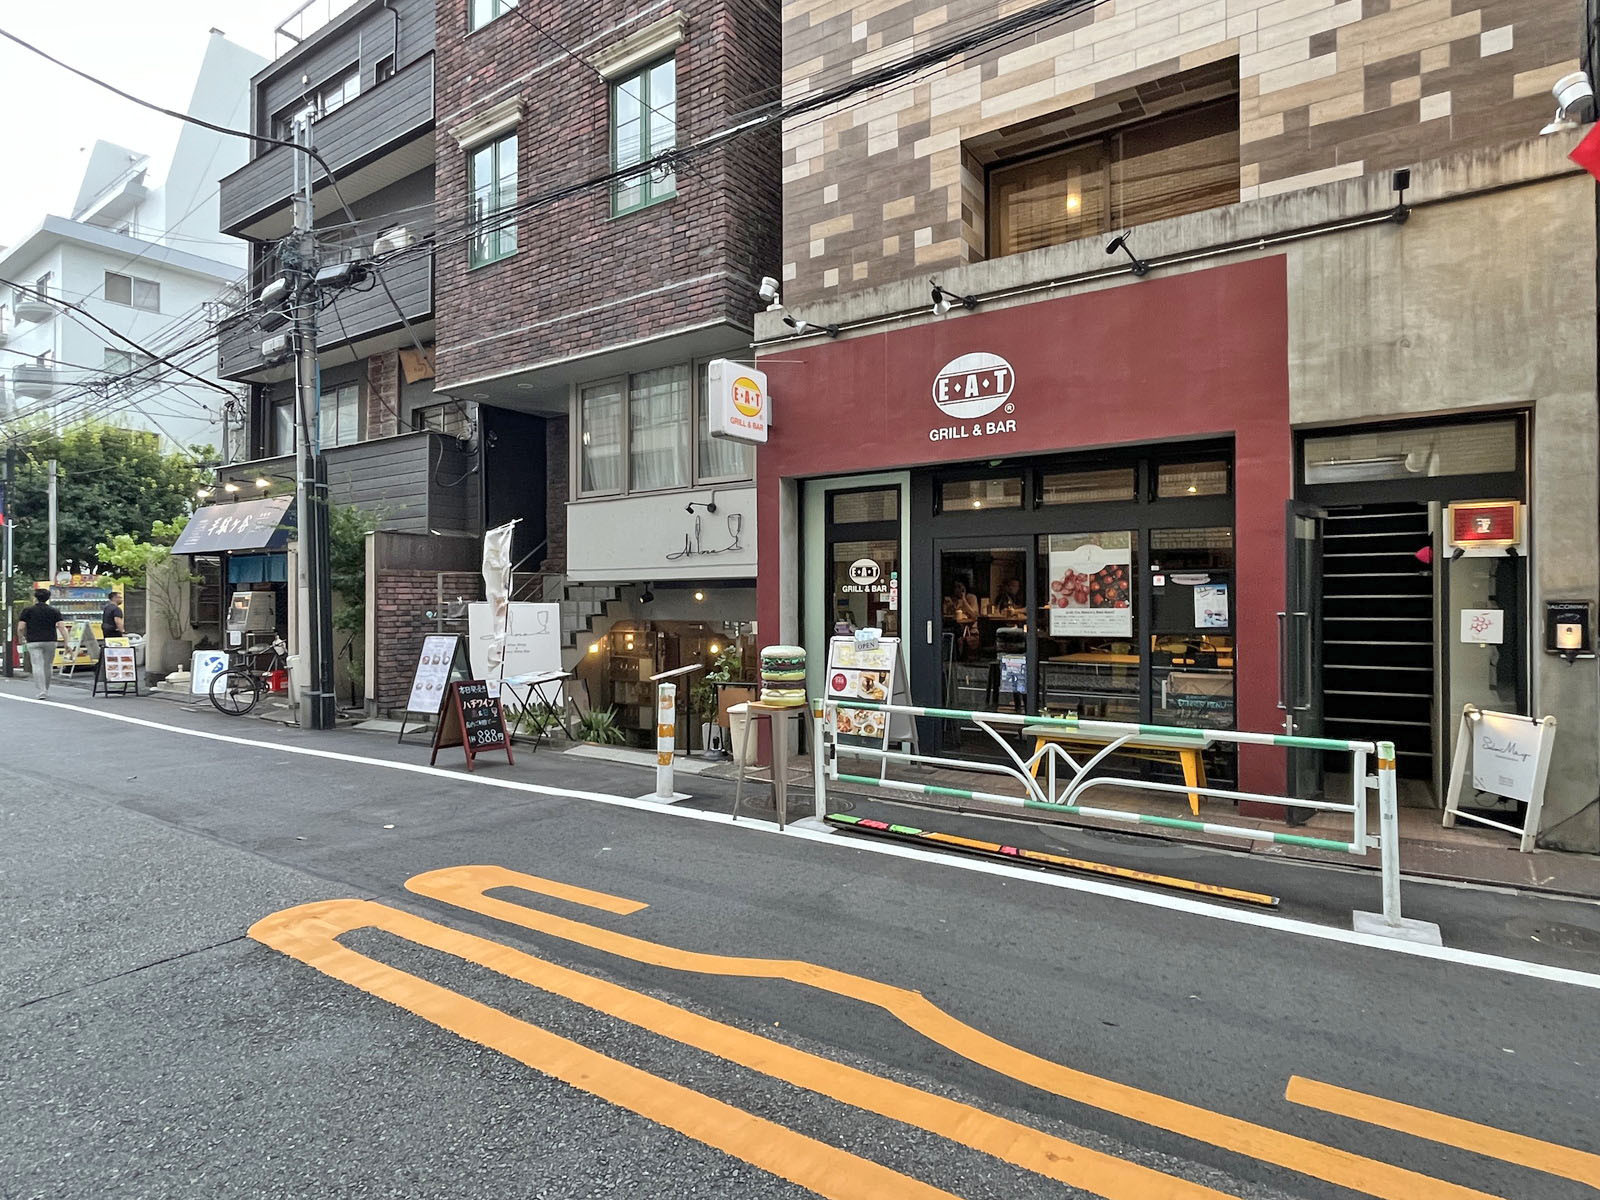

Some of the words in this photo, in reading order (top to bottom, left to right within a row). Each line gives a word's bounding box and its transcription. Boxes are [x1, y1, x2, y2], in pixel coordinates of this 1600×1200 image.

[730, 416, 746, 428] GRILL
[752, 422, 764, 432] BAR
[929, 425, 970, 442] GRILL
[972, 423, 983, 437] &
[985, 419, 1017, 435] BAR
[842, 585, 864, 593] GRILL
[864, 585, 870, 593] &
[871, 585, 887, 593] BAR
[857, 642, 876, 650] OPEN
[477, 729, 504, 744] 888円
